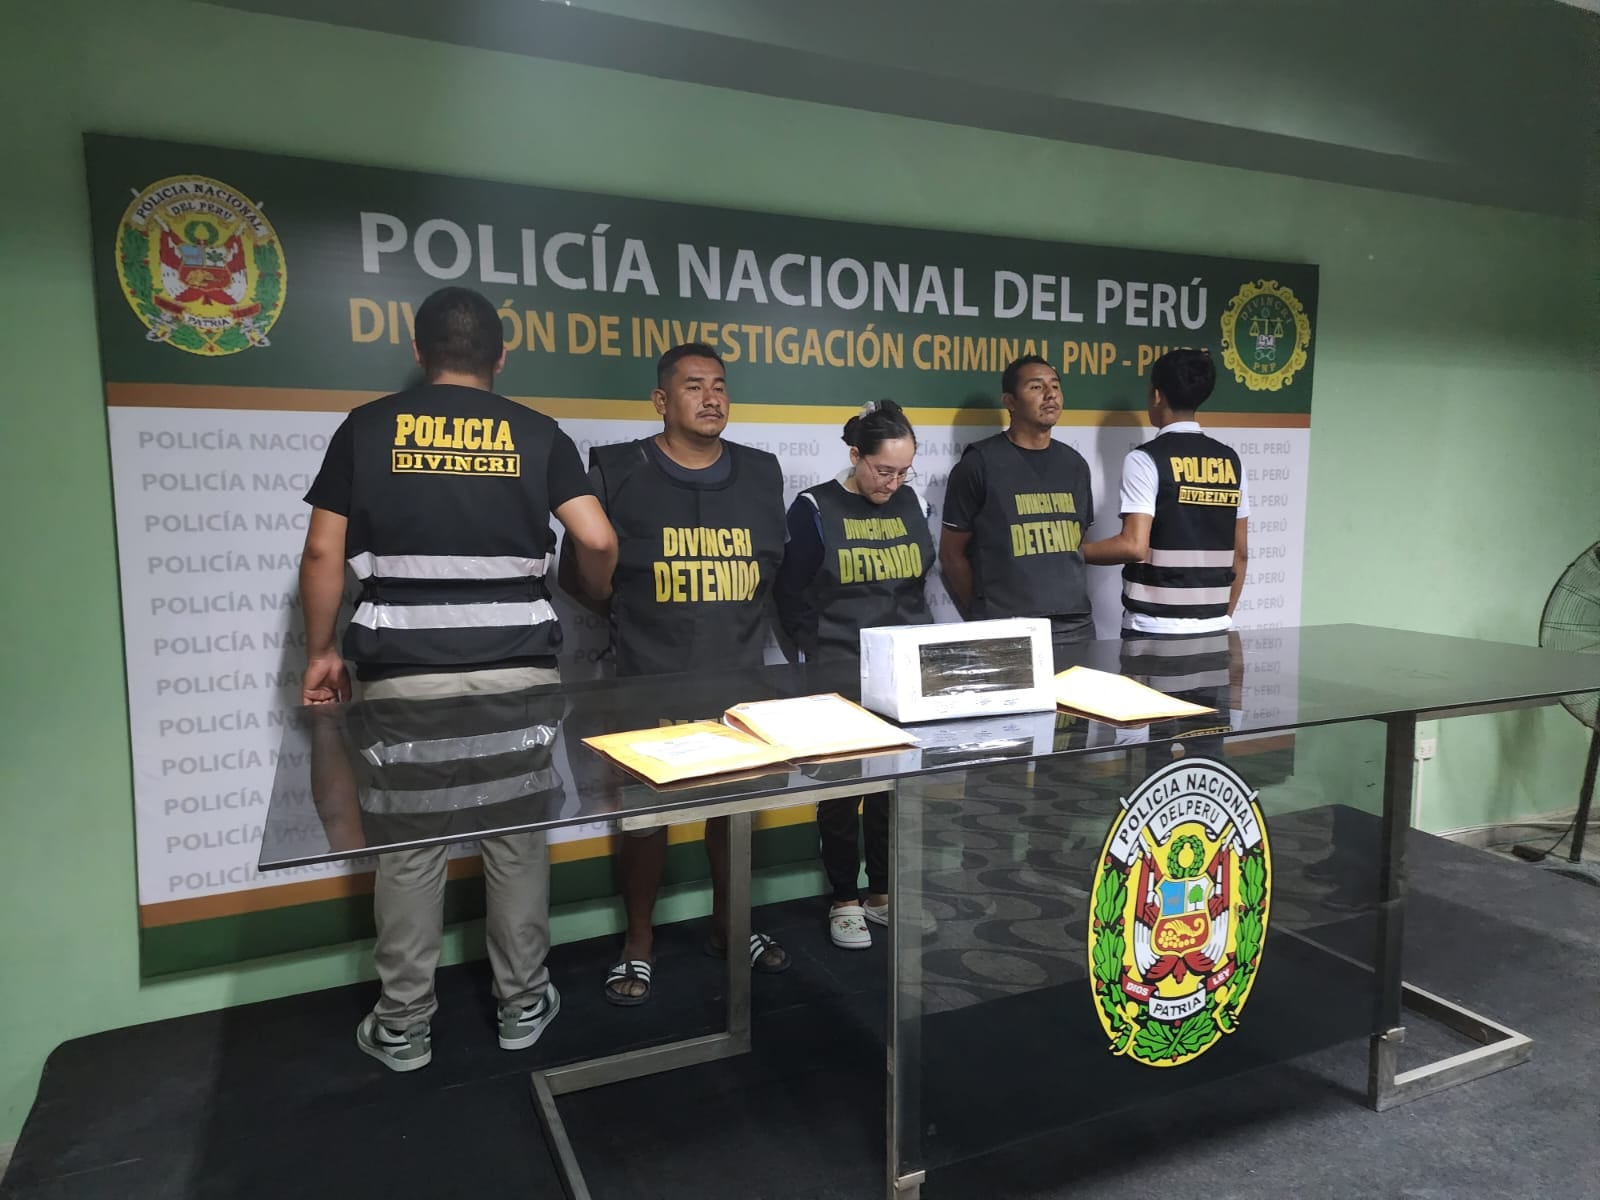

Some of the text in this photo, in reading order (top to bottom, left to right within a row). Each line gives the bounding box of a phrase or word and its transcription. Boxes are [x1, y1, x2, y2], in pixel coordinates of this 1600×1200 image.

[135, 183, 264, 231] POLICIA NACIONAL
[171, 201, 233, 220] DEL PERU
[360, 211, 1208, 330] POLICÍA NACIONAL DEL PERÚ
[187, 316, 231, 328] PATRIA
[567, 312, 622, 357] DE
[631, 317, 904, 370] INVESTIGACIÓN
[1063, 341, 1117, 376] PNP
[1253, 362, 1276, 373] PNP
[138, 428, 329, 451] POLICÍA NACIO
[394, 413, 515, 451] POLICIA
[778, 440, 820, 456] PERÚ
[1240, 442, 1261, 455] DEL
[1264, 440, 1291, 455] PERÚ
[396, 453, 516, 473] DIVINCRI
[1169, 456, 1237, 485] POLICÍA
[141, 469, 246, 492] POLICÍA
[1180, 488, 1239, 504] DIVREINT
[144, 510, 248, 533] POLICÍA
[1260, 517, 1288, 533] PERÚ
[662, 526, 753, 558] DIVINCRI
[147, 550, 252, 576] POLICÍA
[837, 543, 923, 585] DETENIDO
[653, 560, 761, 603] DETENIDO
[151, 591, 254, 616] POLICÍA
[153, 630, 256, 657] POLICÍA
[156, 669, 259, 697] POLICÍA
[158, 709, 261, 738] POLICÍA
[160, 748, 262, 777] POLICÍA
[163, 787, 265, 816] POLICÍA
[1119, 773, 1253, 845] POLICIA NACIONAL
[166, 824, 264, 854] POLICÍA
[1125, 981, 1150, 997] DIOS
[1212, 968, 1231, 986] LEY
[1153, 996, 1203, 1017] PATRIA
